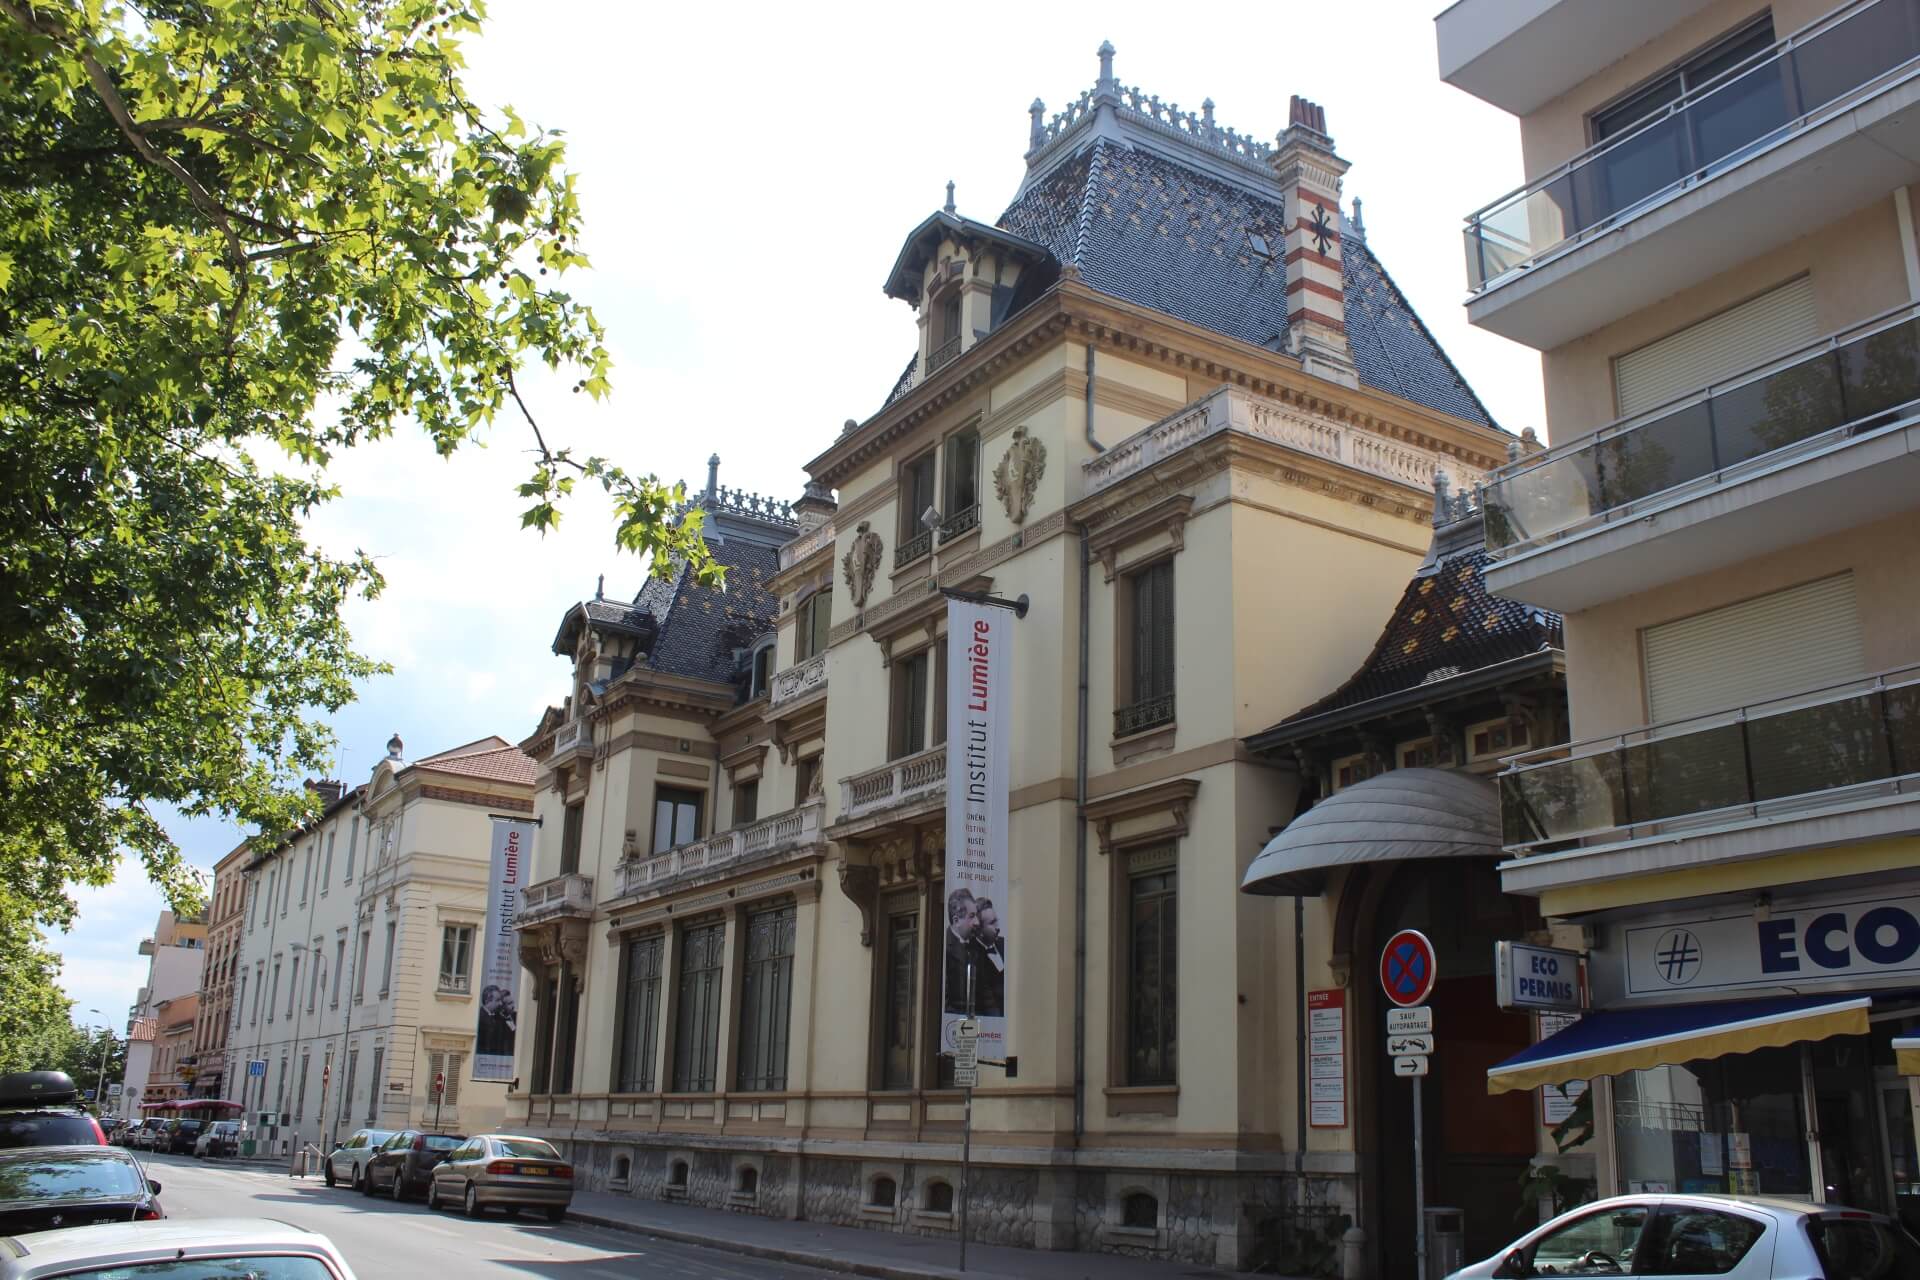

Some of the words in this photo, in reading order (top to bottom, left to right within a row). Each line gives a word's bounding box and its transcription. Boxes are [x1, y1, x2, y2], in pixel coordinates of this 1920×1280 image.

[967, 620, 990, 712] Lumière
[967, 719, 988, 803] Institut
[502, 831, 520, 885] Lumière
[498, 888, 516, 937] Institut
[1758, 906, 1920, 974] ECO
[1519, 977, 1573, 1001] PERMIS
[1531, 955, 1559, 976] ECO
[1389, 1021, 1428, 1030] AUTOPARTAGE
[1399, 1012, 1416, 1020] SAUF
